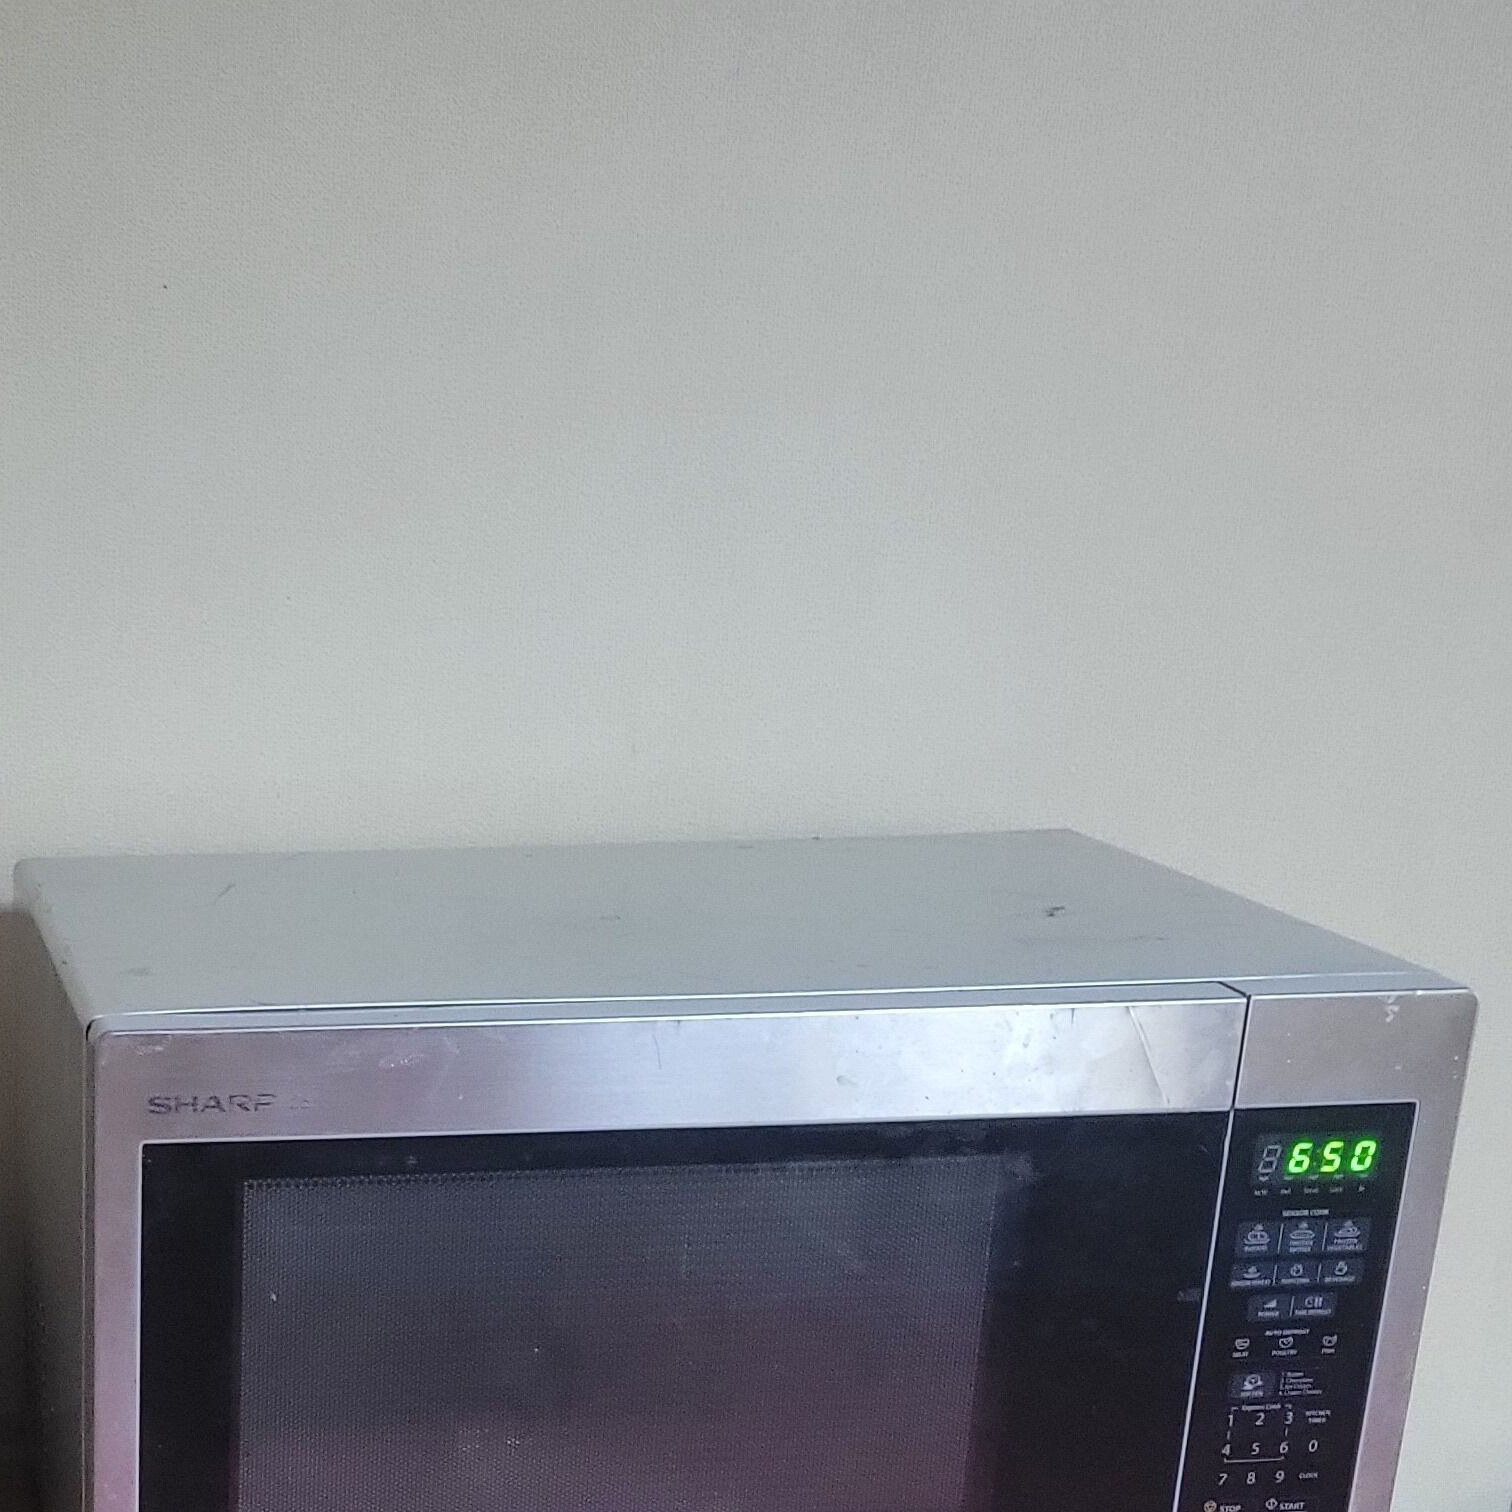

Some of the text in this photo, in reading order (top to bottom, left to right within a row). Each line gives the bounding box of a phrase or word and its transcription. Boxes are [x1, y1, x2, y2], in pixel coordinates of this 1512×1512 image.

[1255, 1412, 1265, 1426] 2
[1284, 1411, 1294, 1425] 3
[1221, 1443, 1231, 1456] 4
[1251, 1442, 1261, 1455] 5
[1279, 1441, 1289, 1454] 6
[1308, 1439, 1319, 1453] 0
[1218, 1473, 1229, 1486] 7
[1246, 1471, 1256, 1485] 8
[1274, 1470, 1285, 1483] 9
[1278, 1502, 1305, 1511] START
